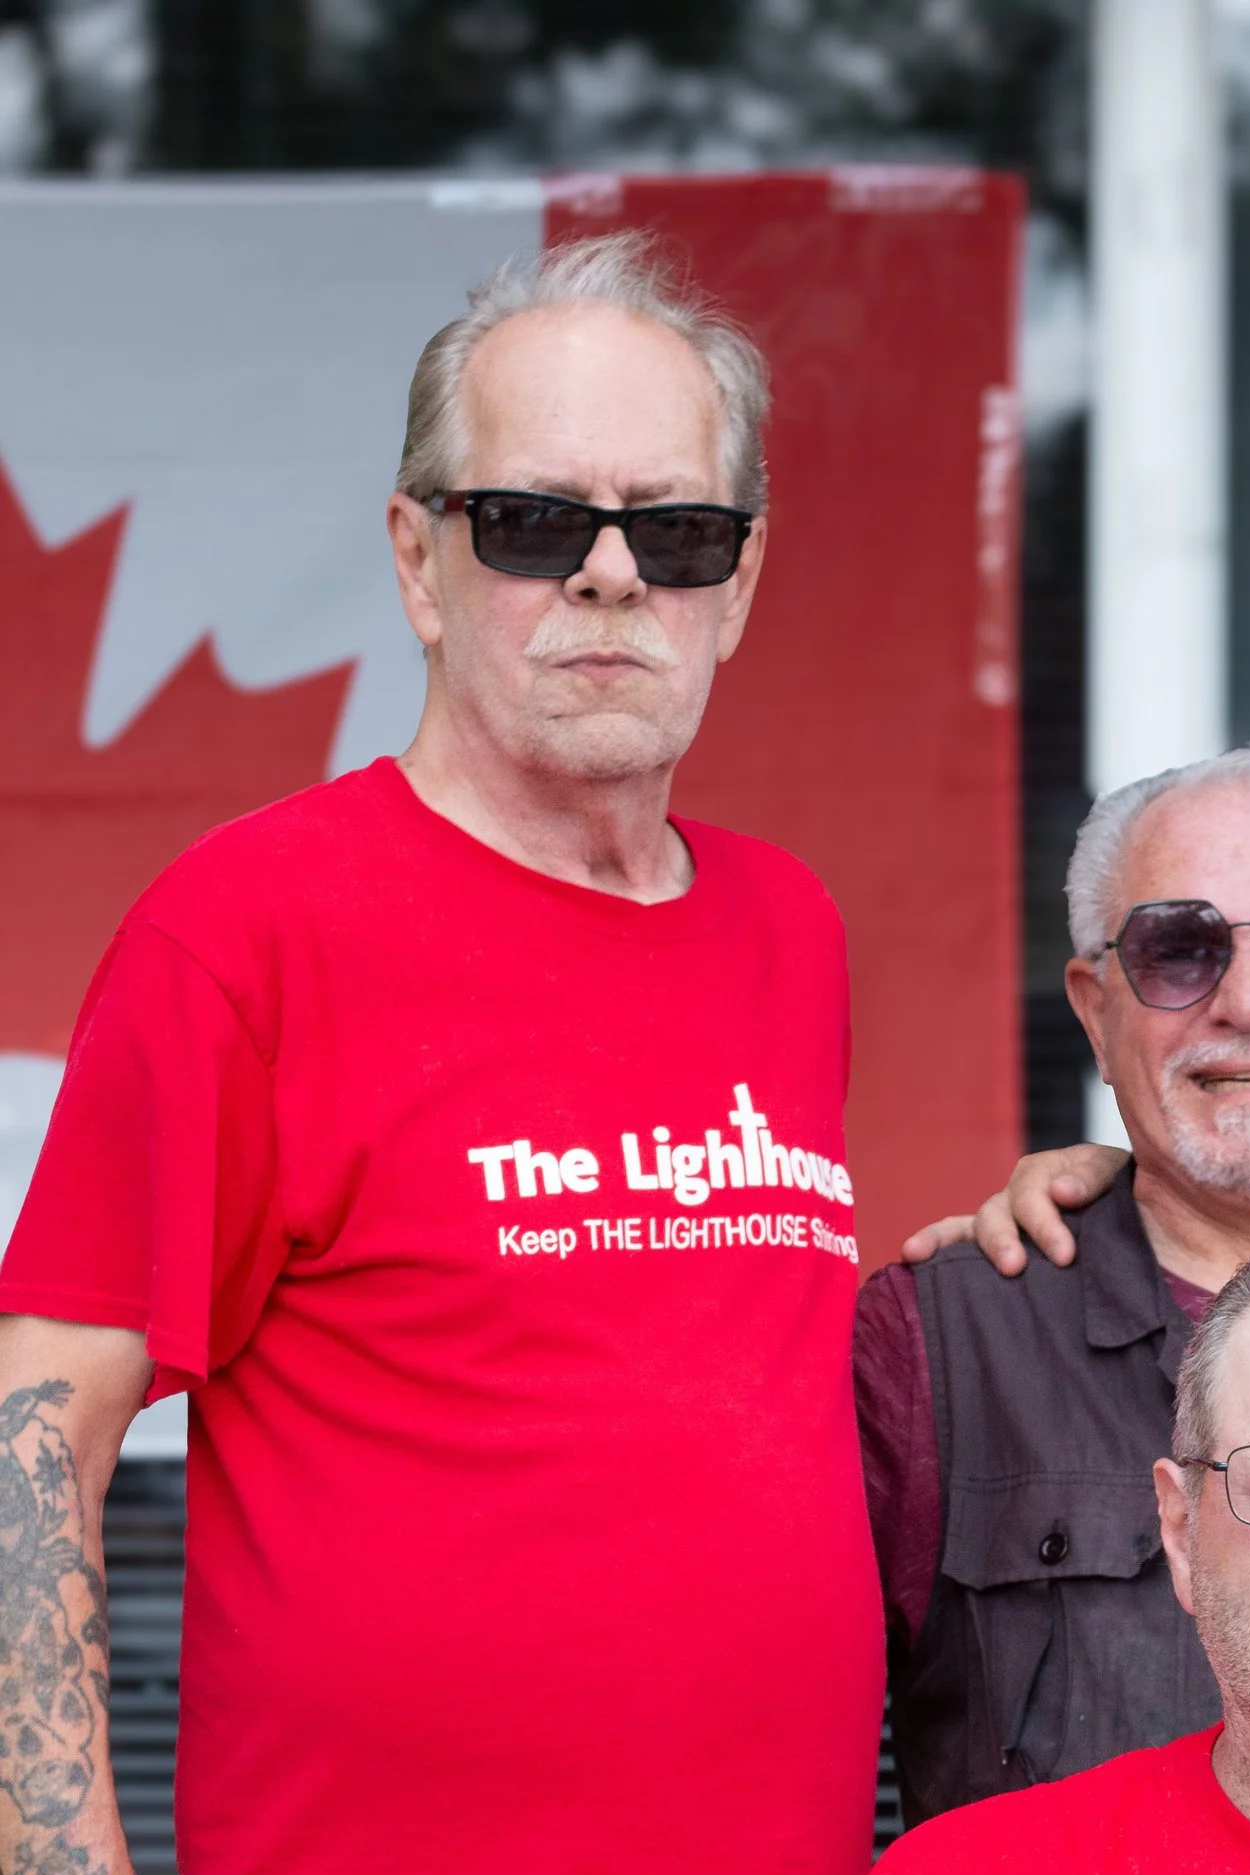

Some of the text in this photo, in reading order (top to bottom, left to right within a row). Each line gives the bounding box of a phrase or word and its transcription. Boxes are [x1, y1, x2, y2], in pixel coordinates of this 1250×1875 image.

[467, 1082, 855, 1206] The Lighthouse
[498, 1225, 577, 1259] Keep
[582, 1217, 643, 1251] THE
[649, 1213, 809, 1250] LIGHTHOUSE
